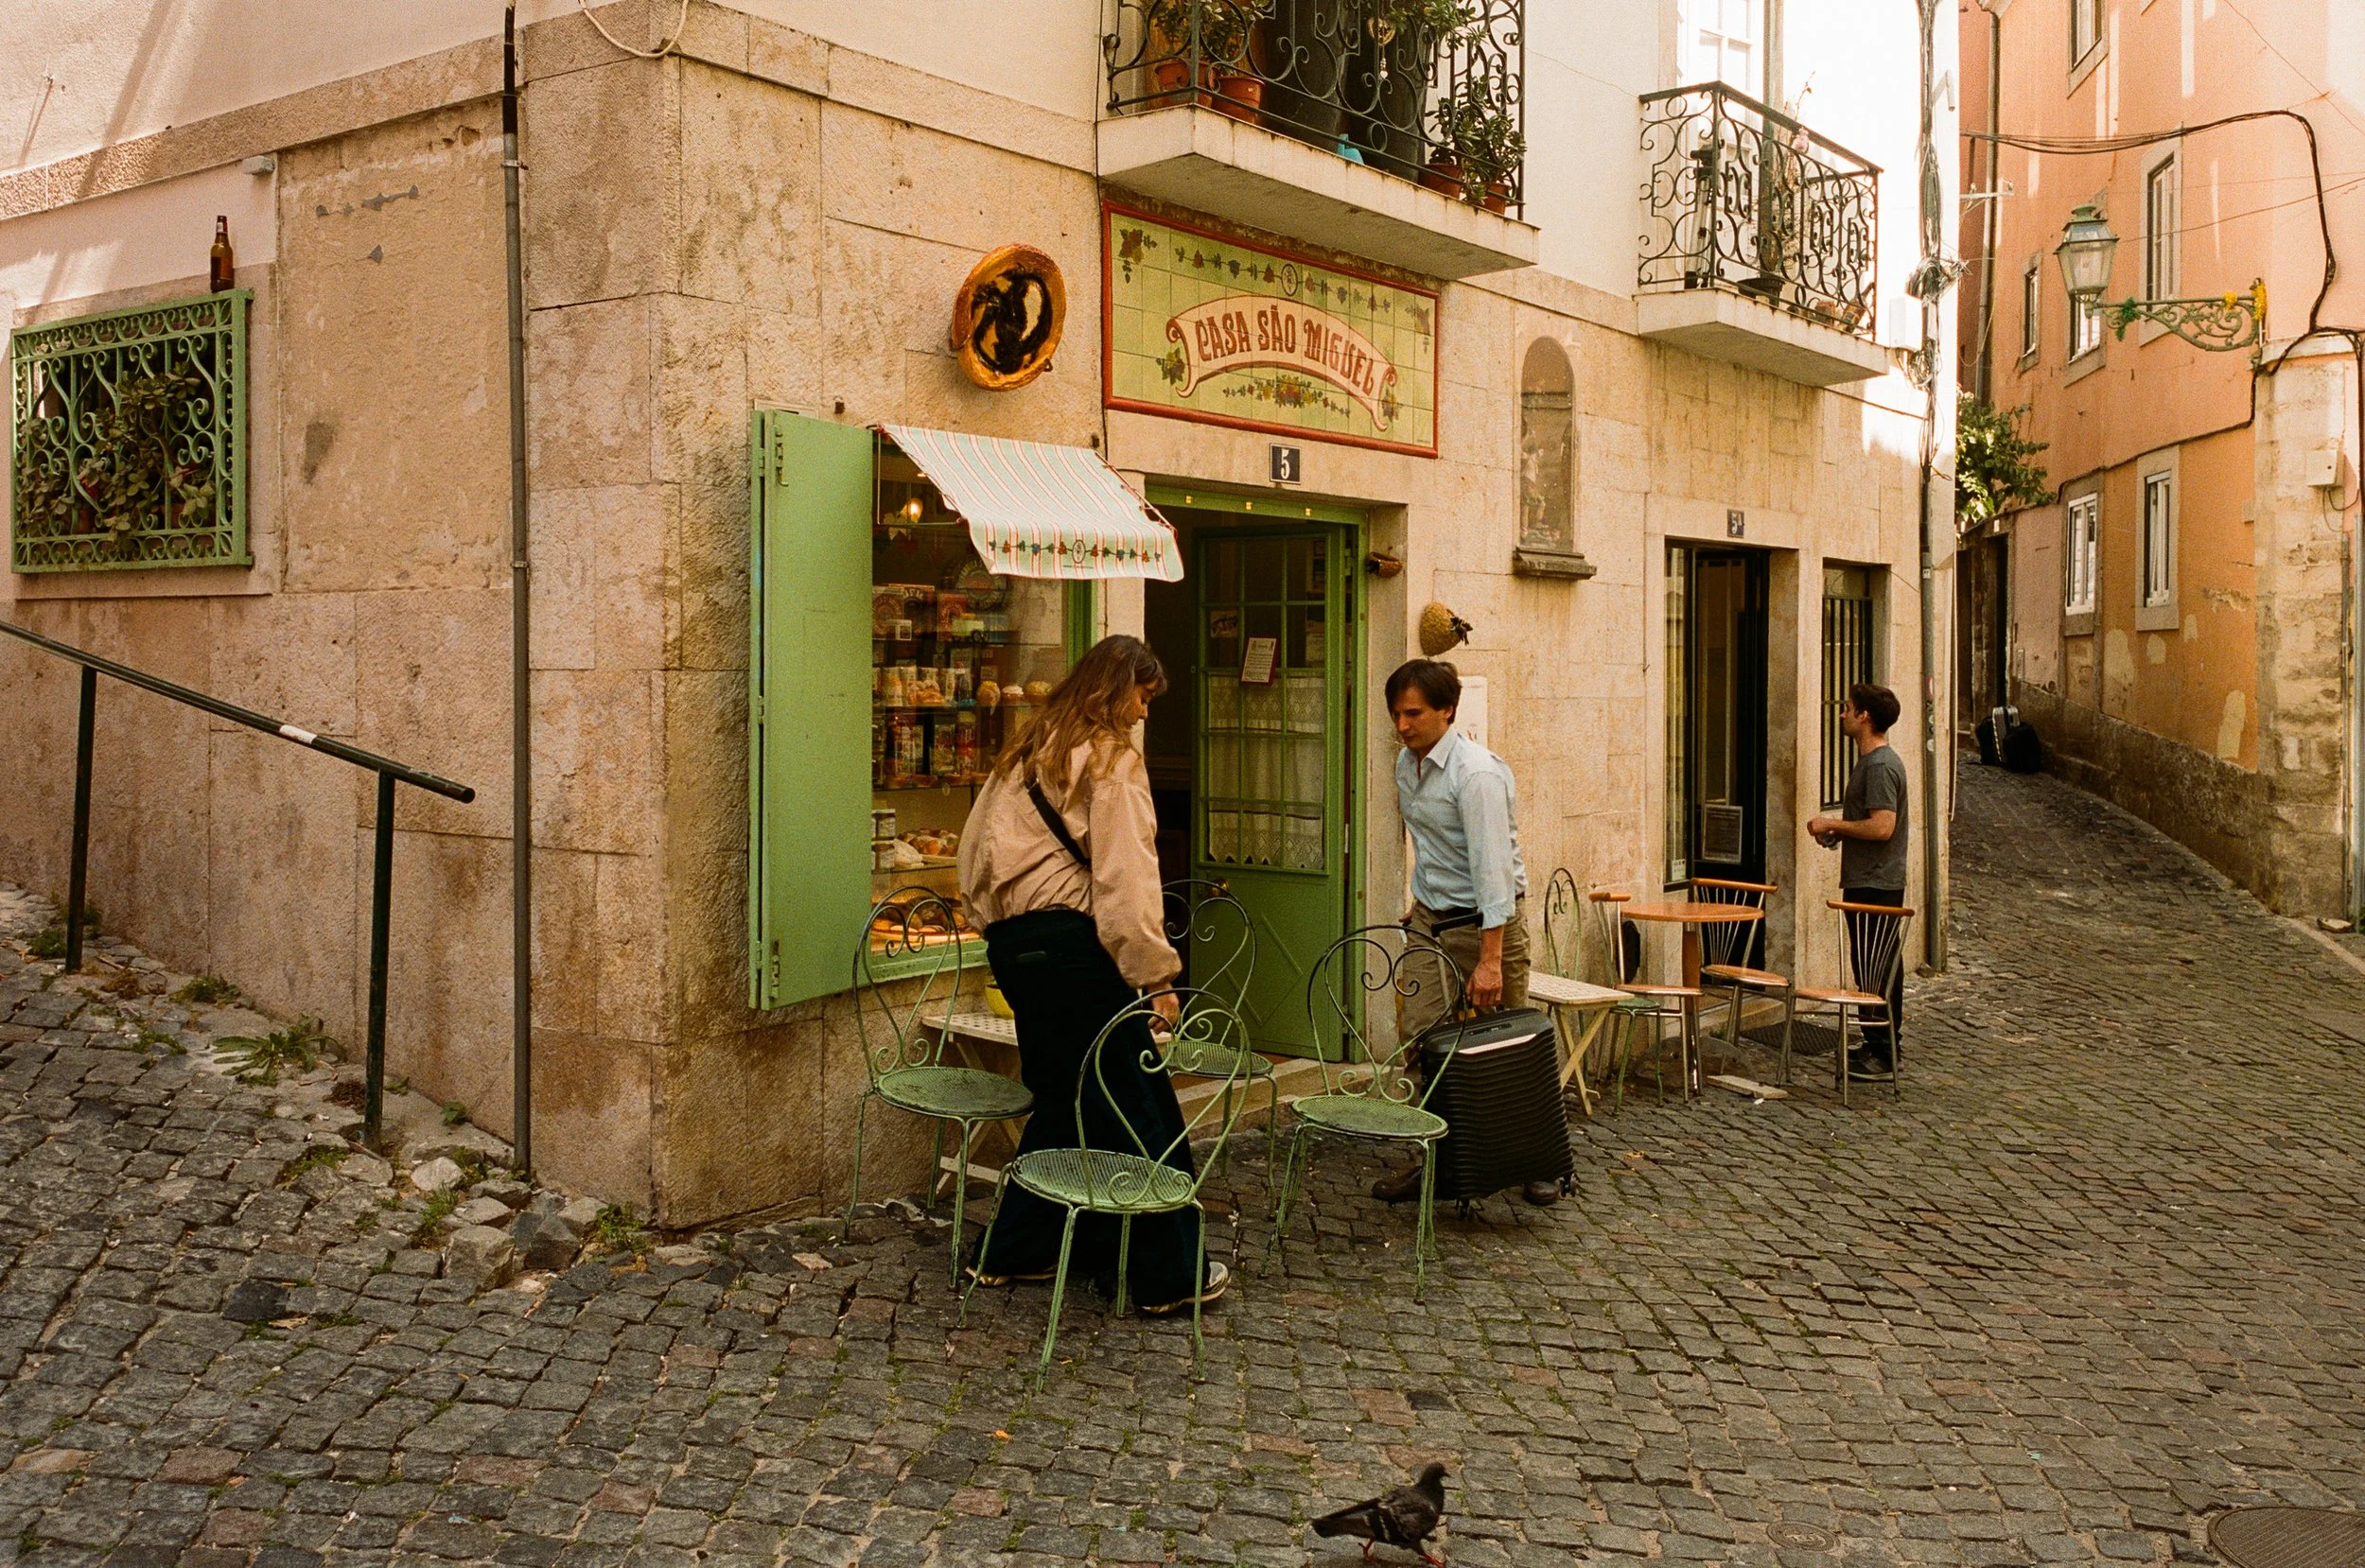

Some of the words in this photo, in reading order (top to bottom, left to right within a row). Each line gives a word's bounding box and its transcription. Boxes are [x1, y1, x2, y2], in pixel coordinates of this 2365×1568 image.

[1196, 311, 1252, 361] CASA
[1257, 305, 1296, 354] SÃO
[1304, 319, 1376, 394] MIGUEL
[1280, 448, 1290, 480] 5
